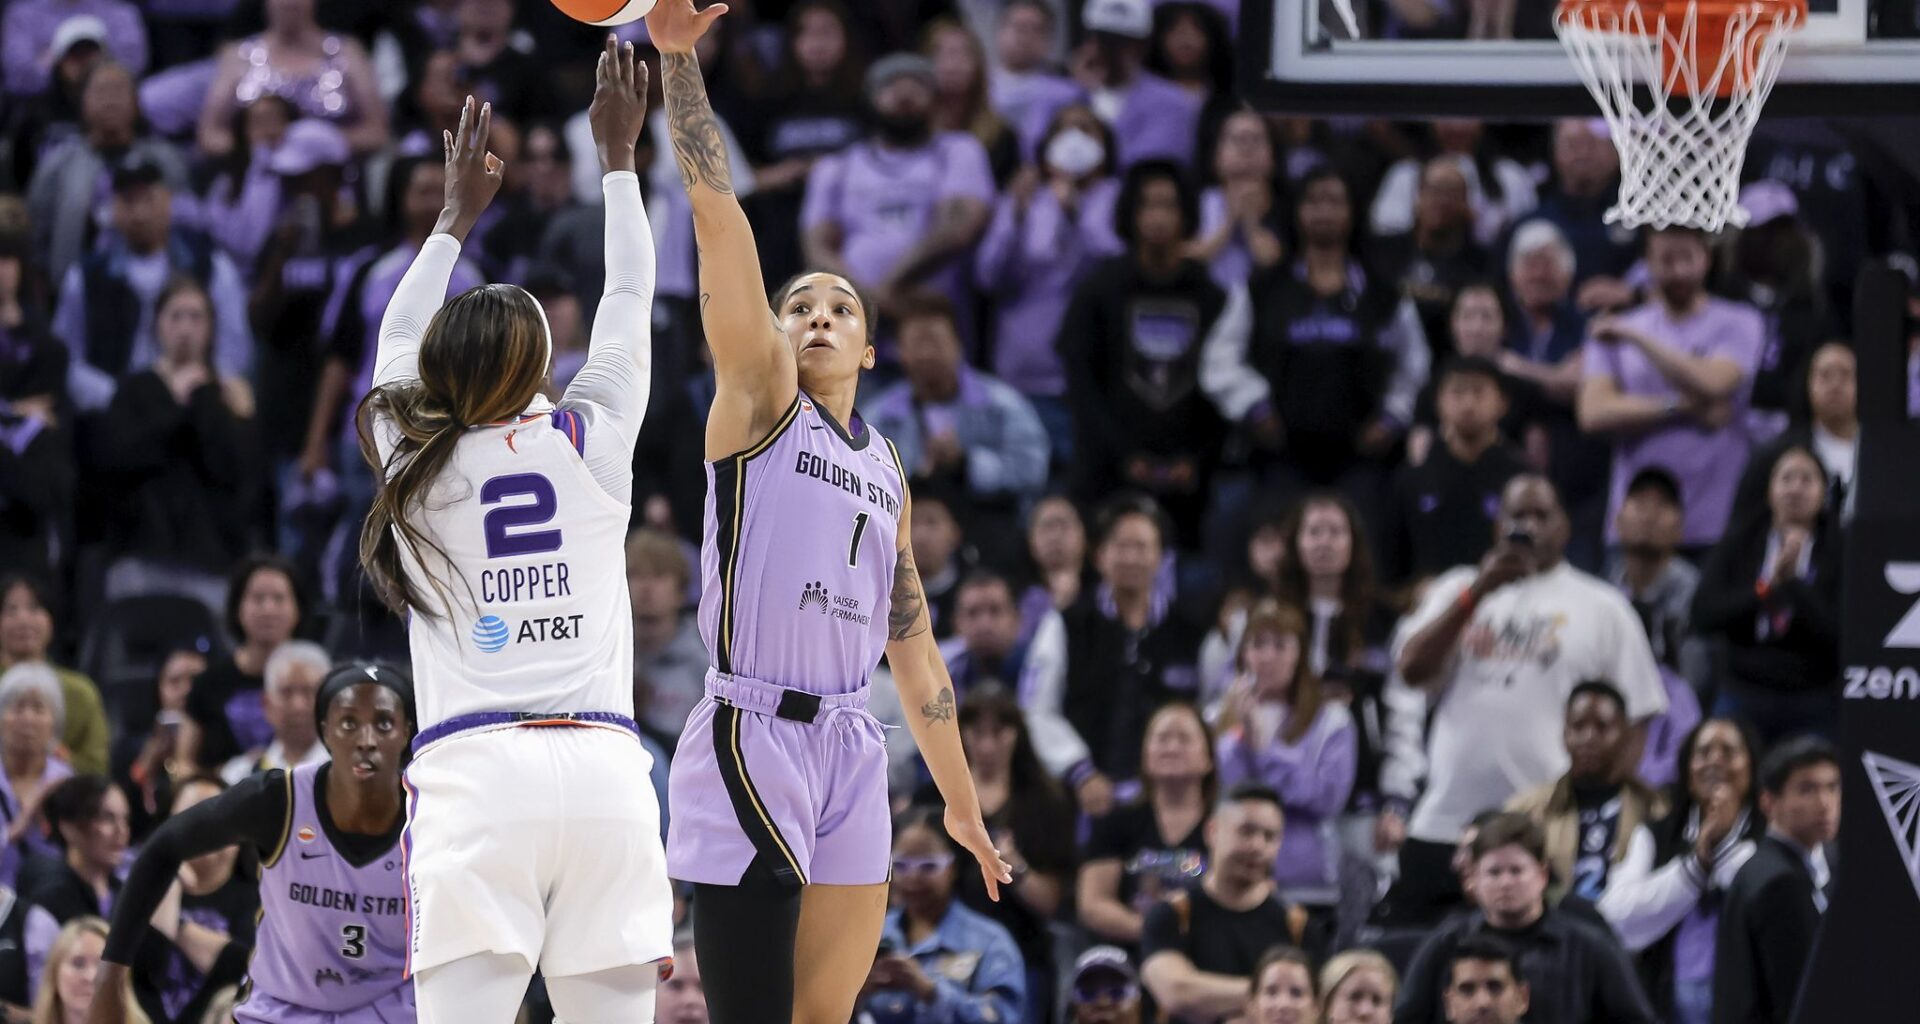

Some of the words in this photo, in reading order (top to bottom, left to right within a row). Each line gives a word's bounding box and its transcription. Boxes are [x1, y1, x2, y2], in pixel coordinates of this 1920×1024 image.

[795, 450, 862, 498] GOLDEN
[480, 472, 563, 559] 2
[848, 511, 870, 568] 1
[481, 562, 571, 603] COPPER
[833, 595, 859, 610] KAISER
[516, 614, 584, 643] AT&T
[1843, 665, 1920, 700] zen
[289, 882, 357, 912] GOLDEN
[361, 895, 407, 915] STAT
[341, 924, 366, 960] 3
